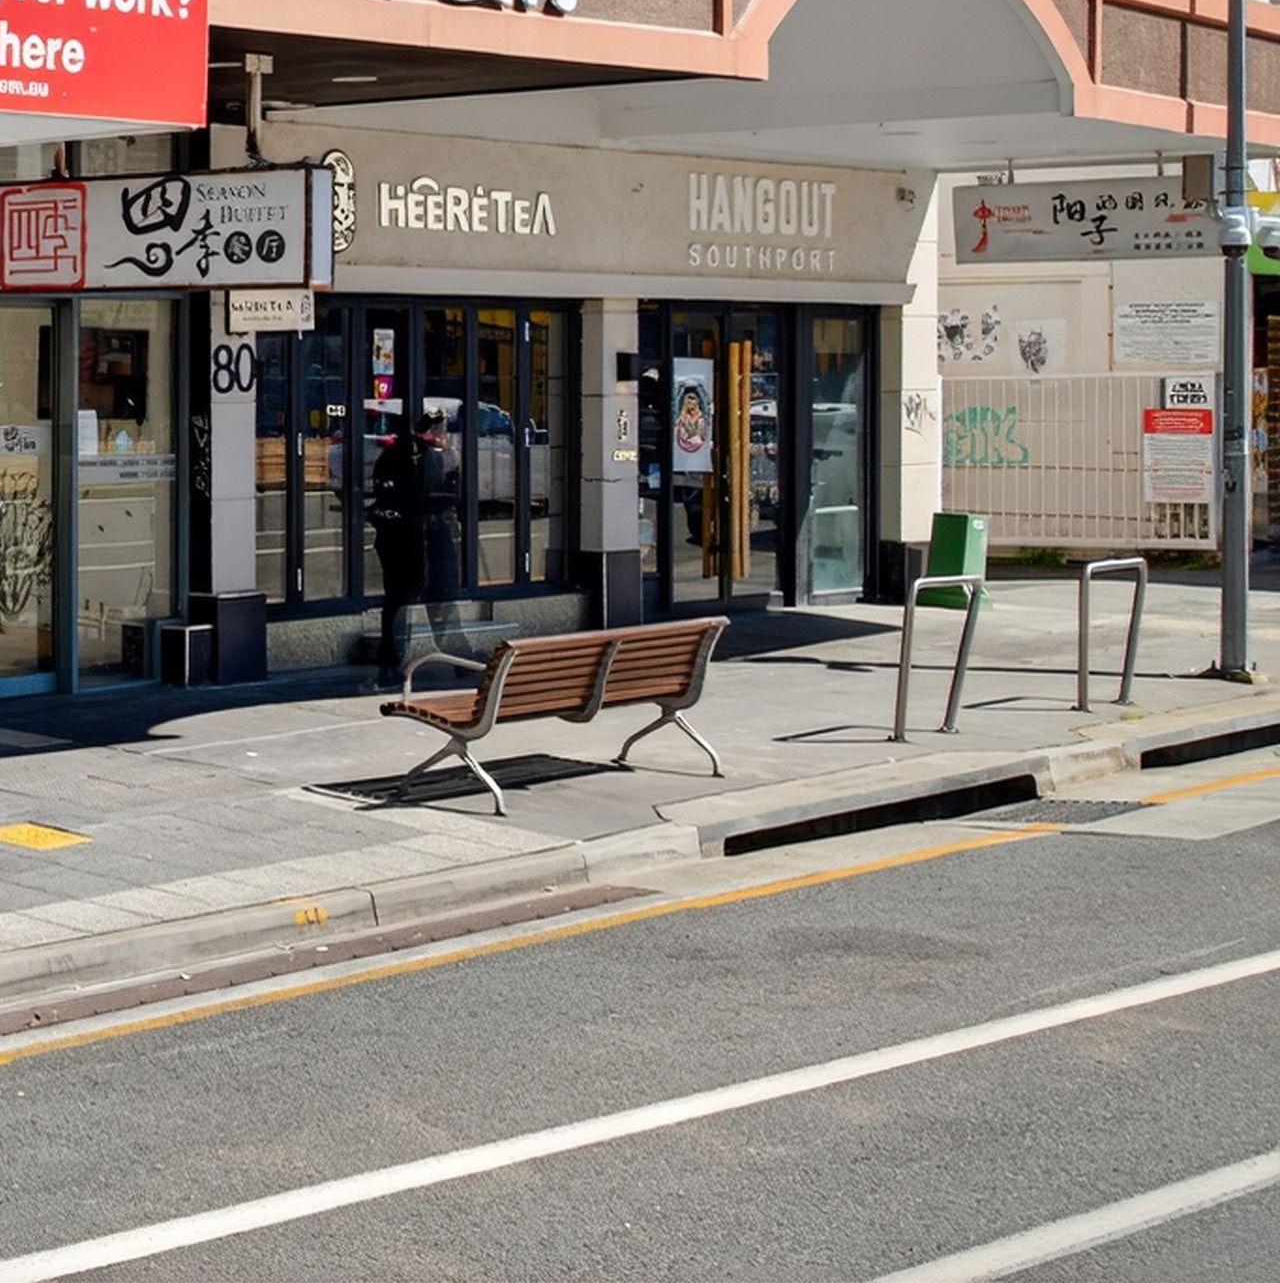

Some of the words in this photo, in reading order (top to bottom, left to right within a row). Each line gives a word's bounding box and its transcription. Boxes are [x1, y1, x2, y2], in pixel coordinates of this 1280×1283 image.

[195, 183, 267, 203] SEASON
[688, 171, 837, 239] HANGOUT
[219, 204, 289, 224] BUFFET
[688, 242, 837, 273] SOUTHPORT
[212, 343, 256, 395] 80
